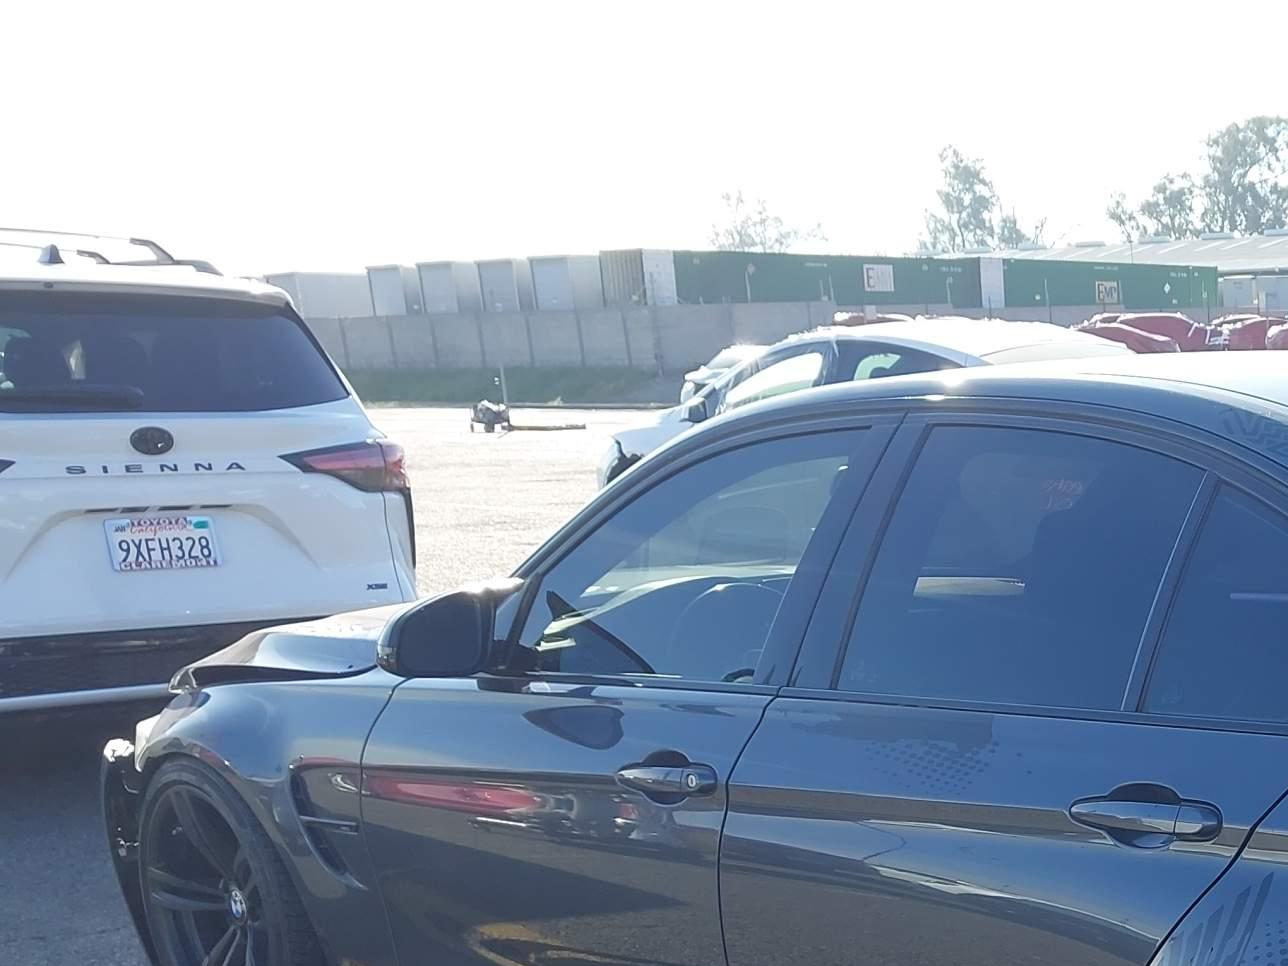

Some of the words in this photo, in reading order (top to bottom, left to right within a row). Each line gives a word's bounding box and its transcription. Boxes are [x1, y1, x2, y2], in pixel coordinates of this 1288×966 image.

[65, 462, 246, 475] SIENNA
[132, 517, 187, 527] TOYOTA
[118, 535, 212, 563] 9XFH328
